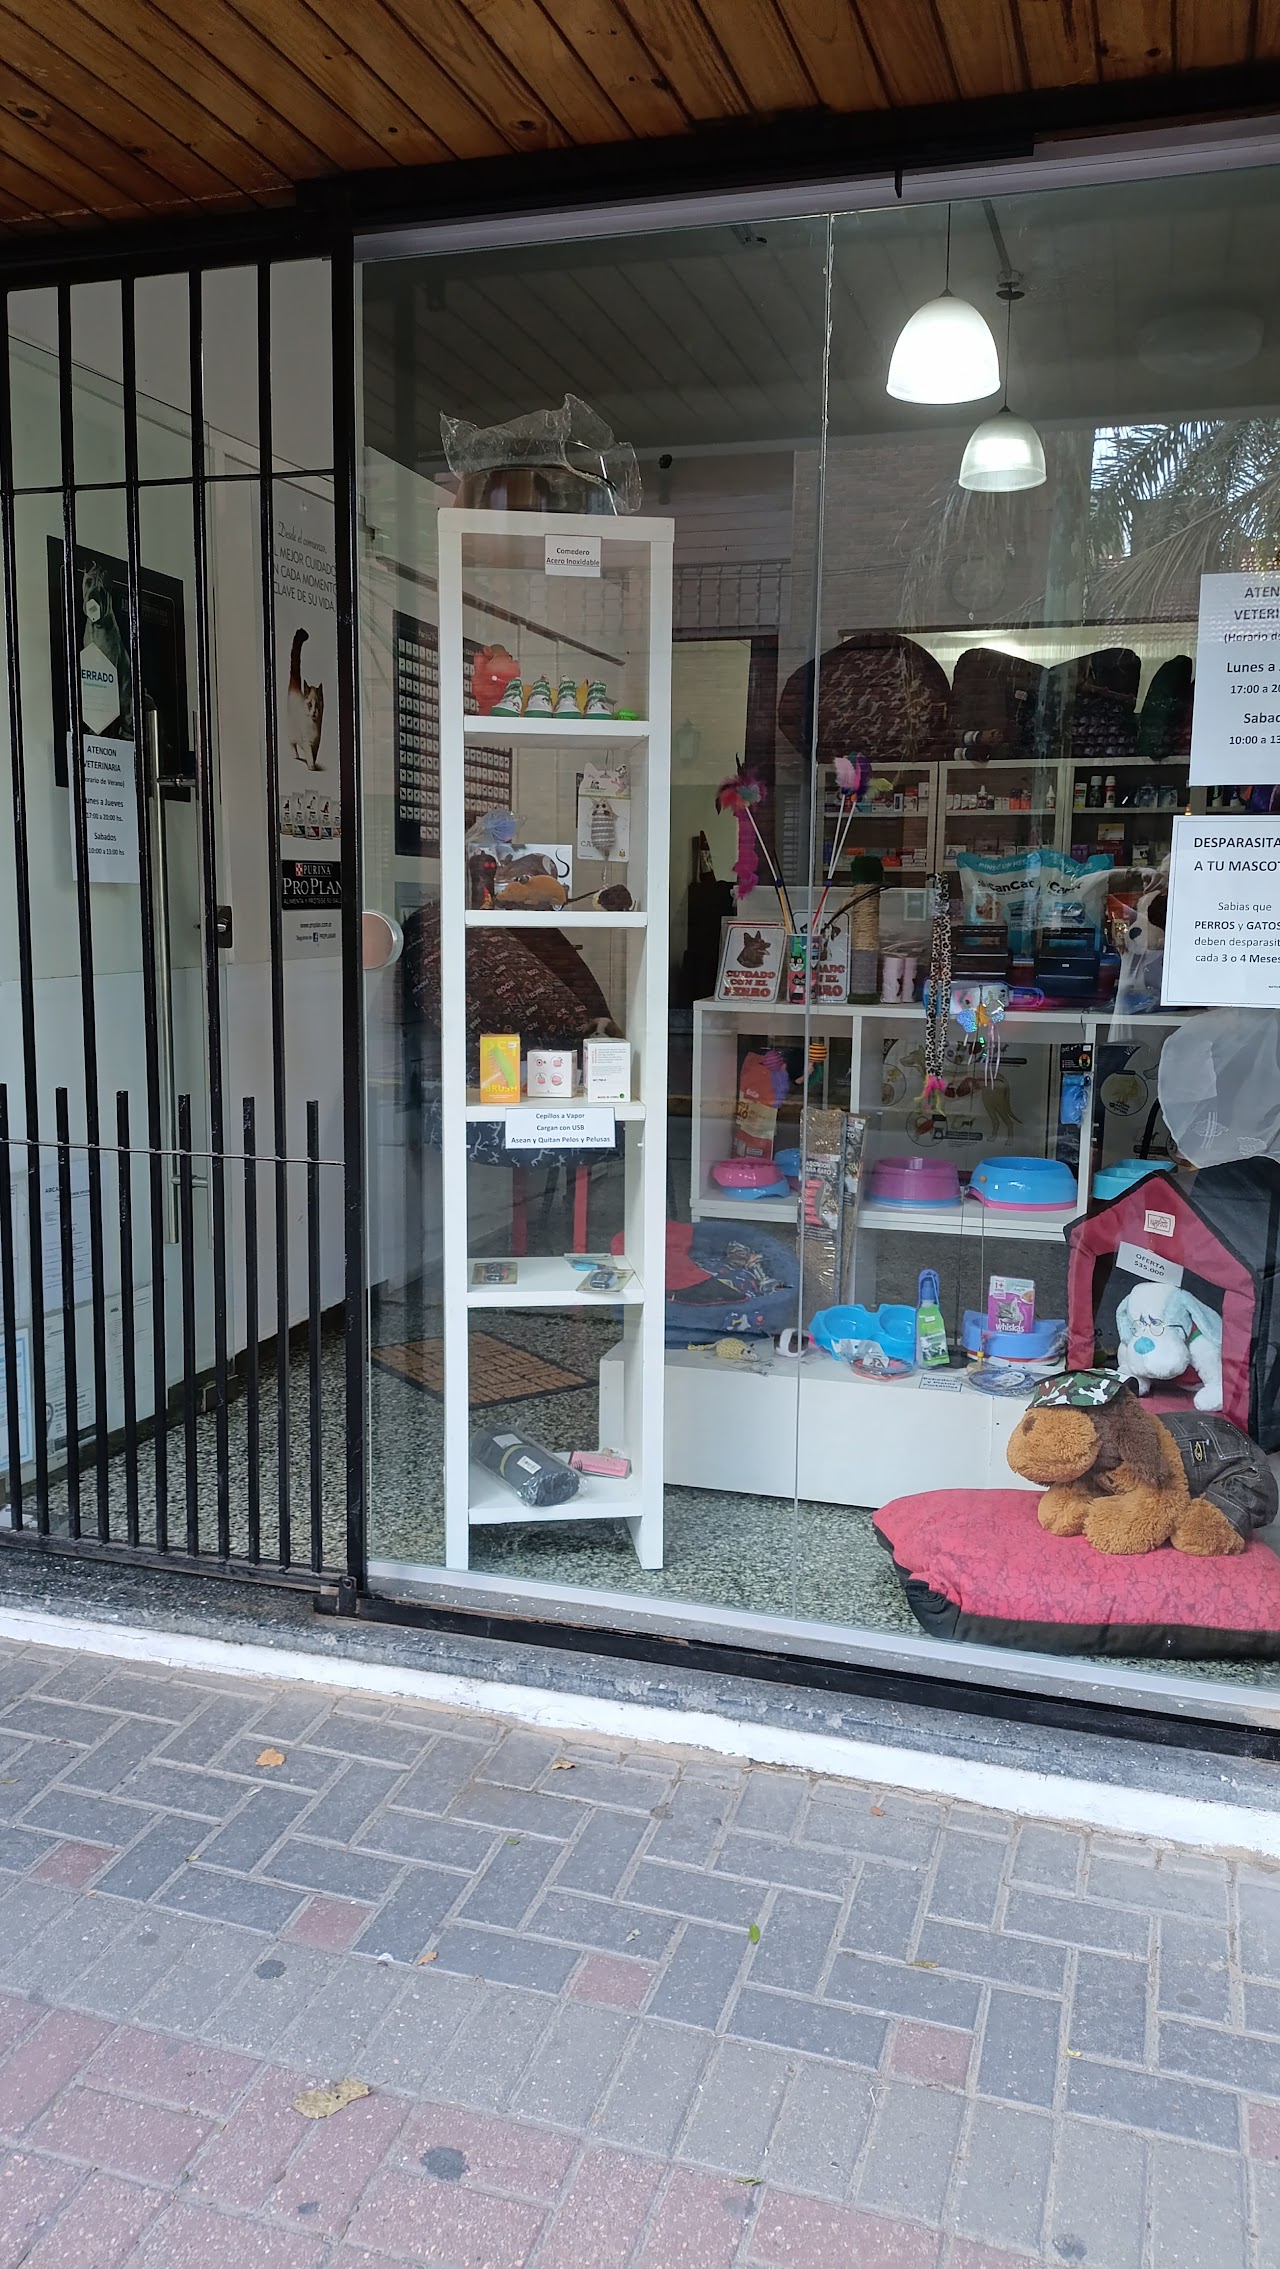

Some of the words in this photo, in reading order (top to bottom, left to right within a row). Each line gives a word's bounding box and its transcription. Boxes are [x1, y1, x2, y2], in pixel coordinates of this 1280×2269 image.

[556, 548, 590, 556] Comedero
[280, 547, 304, 565] MEJOR
[305, 556, 336, 577] CUIDADO
[280, 566, 301, 582] CADA
[297, 589, 306, 602] DE
[1244, 586, 1280, 599] ATEN
[1234, 608, 1280, 620] VETERI
[1224, 632, 1268, 644] (Horario
[1227, 661, 1264, 673] Lunes
[1268, 662, 1276, 672] a
[82, 670, 114, 683] ERRADO
[1231, 684, 1260, 694] 17:00
[1229, 736, 1258, 745] 10:00
[1270, 735, 1280, 744] 13
[87, 745, 116, 756] ATENCION
[105, 798, 124, 808] Jueves
[94, 832, 116, 842] Sabados
[1194, 837, 1280, 848] DESPARASITA
[304, 864, 331, 874] PURINA
[1194, 860, 1204, 872] A
[1207, 860, 1224, 872] TU
[1218, 902, 1250, 911] Sabias
[1252, 904, 1272, 912] que
[1194, 921, 1234, 930] PERROS
[1238, 923, 1244, 931] y
[1246, 922, 1280, 930] GATOS
[1194, 937, 1226, 946] deben
[1228, 937, 1280, 948] desparasit
[1196, 953, 1218, 962] cada
[1222, 954, 1228, 962] 3
[1240, 954, 1246, 962] 4
[1250, 954, 1280, 963] Meses
[726, 970, 776, 979] CUIDADO
[730, 978, 752, 986] CON
[754, 978, 768, 986] EL
[724, 986, 770, 998] PERRO
[805, 1160, 830, 1168] ASCADOR
[1136, 1253, 1165, 1270] OFERTA
[1134, 1260, 1165, 1276] $35.000
[995, 1320, 1024, 1334] whiskas
